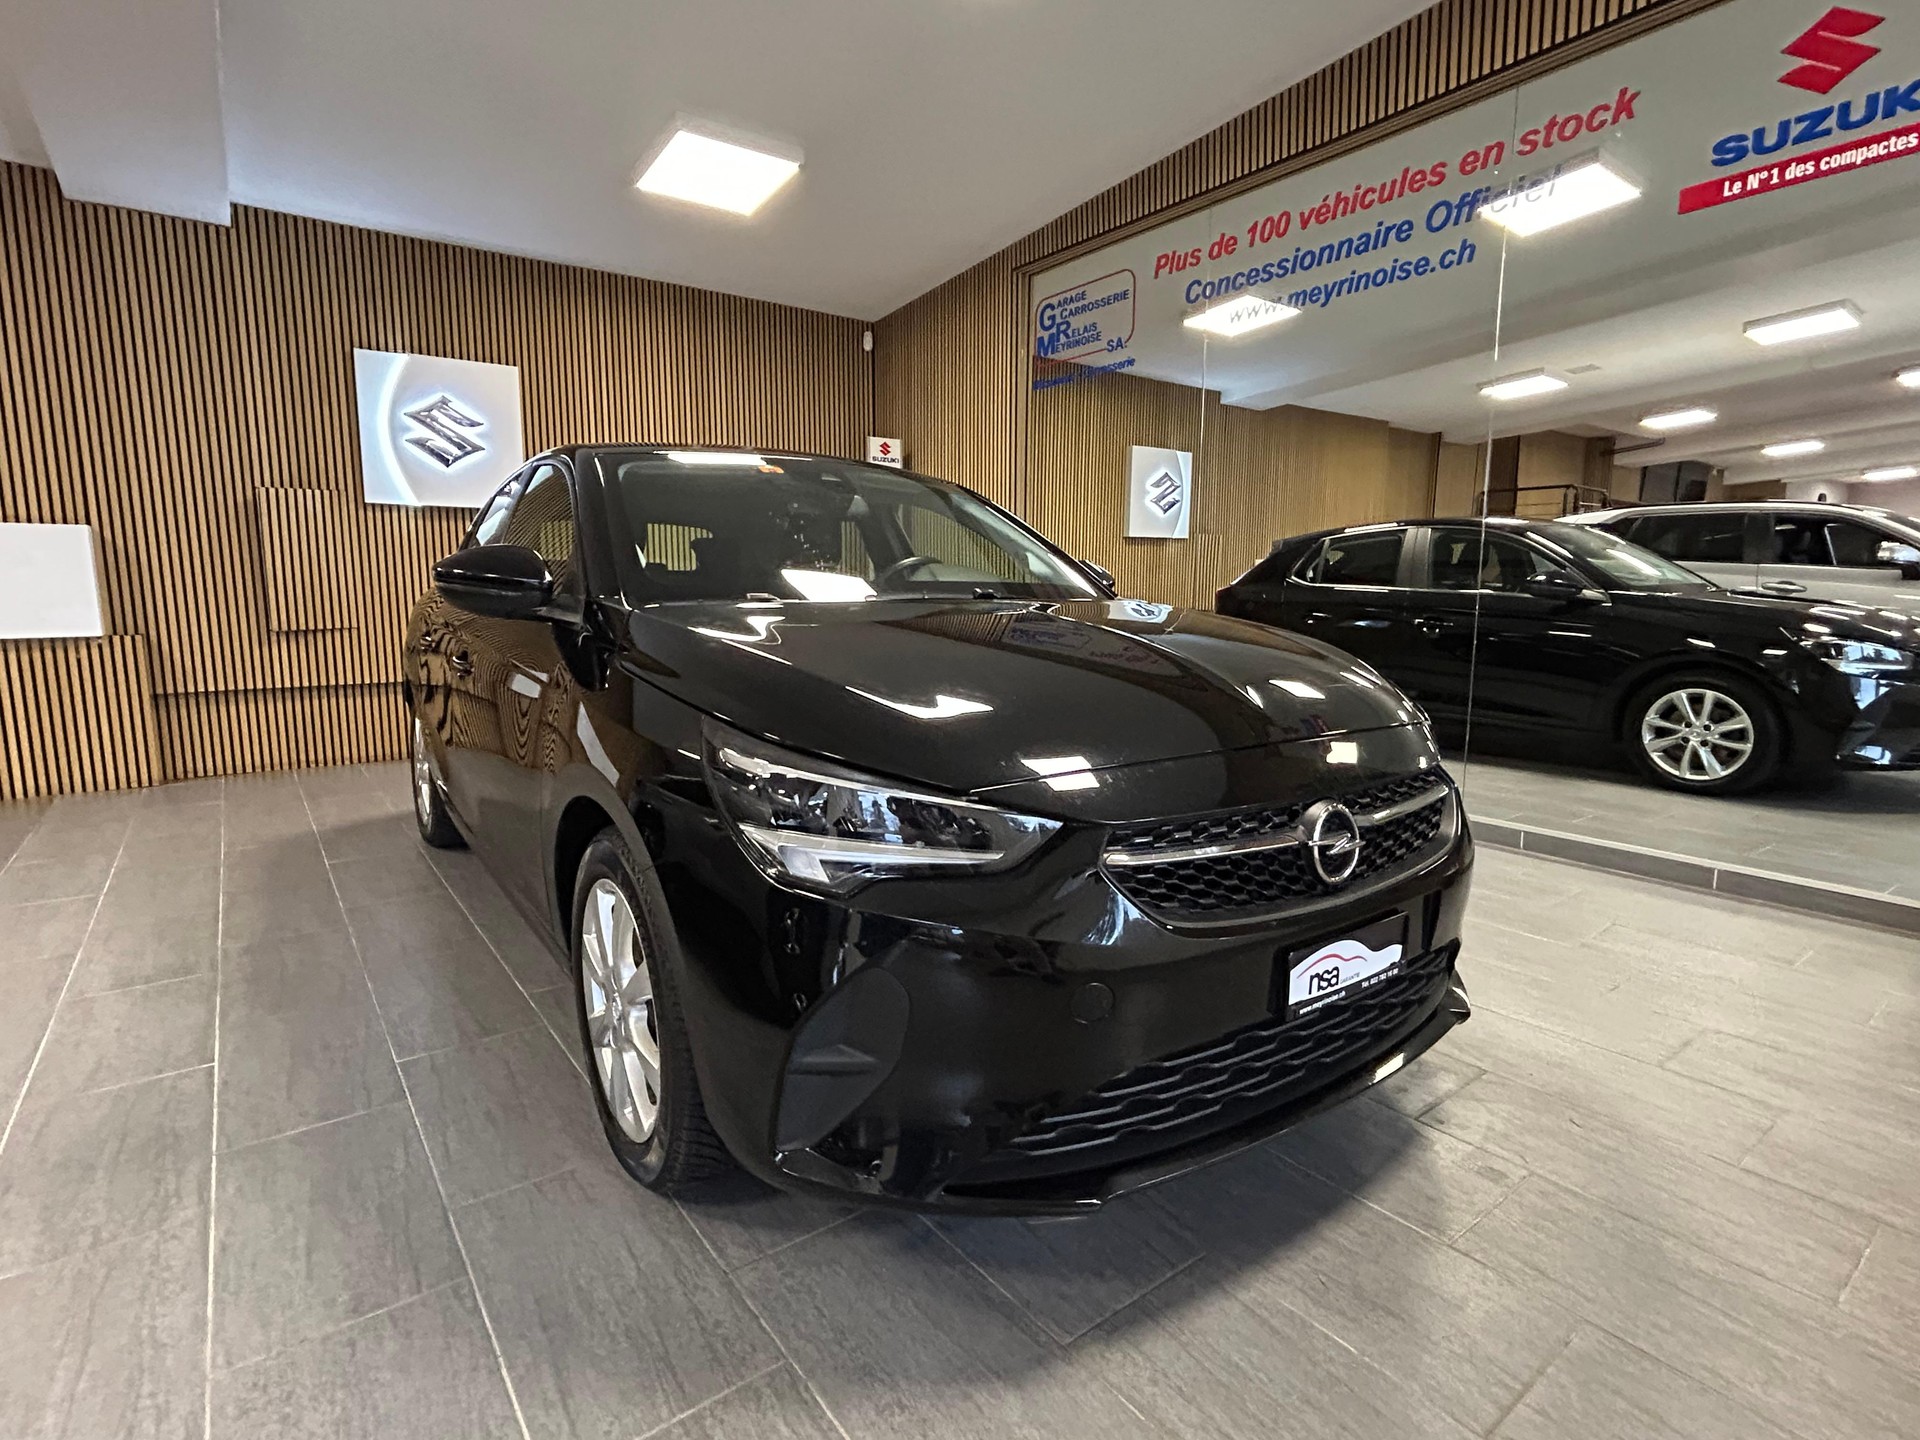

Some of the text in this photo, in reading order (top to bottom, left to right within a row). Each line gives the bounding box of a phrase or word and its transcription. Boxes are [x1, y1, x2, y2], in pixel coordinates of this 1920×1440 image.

[1711, 78, 1920, 167] SUZUK
[1153, 86, 1642, 279] Plus de 100 véhicules en stock
[1723, 179, 1743, 198] Le
[1784, 160, 1816, 181] des
[1820, 131, 1919, 171] compactes
[1184, 163, 1564, 304] Concessionnaire Officiel
[1229, 238, 1477, 324] www.meyrinoise.ch
[1039, 290, 1087, 332] GARAGE
[1060, 288, 1130, 320] CARROSSERIE
[1037, 330, 1102, 358] MEYRINOISE
[1056, 320, 1098, 343] RELAIS
[872, 456, 900, 464] SUZUKI
[1308, 966, 1340, 995] nsa
